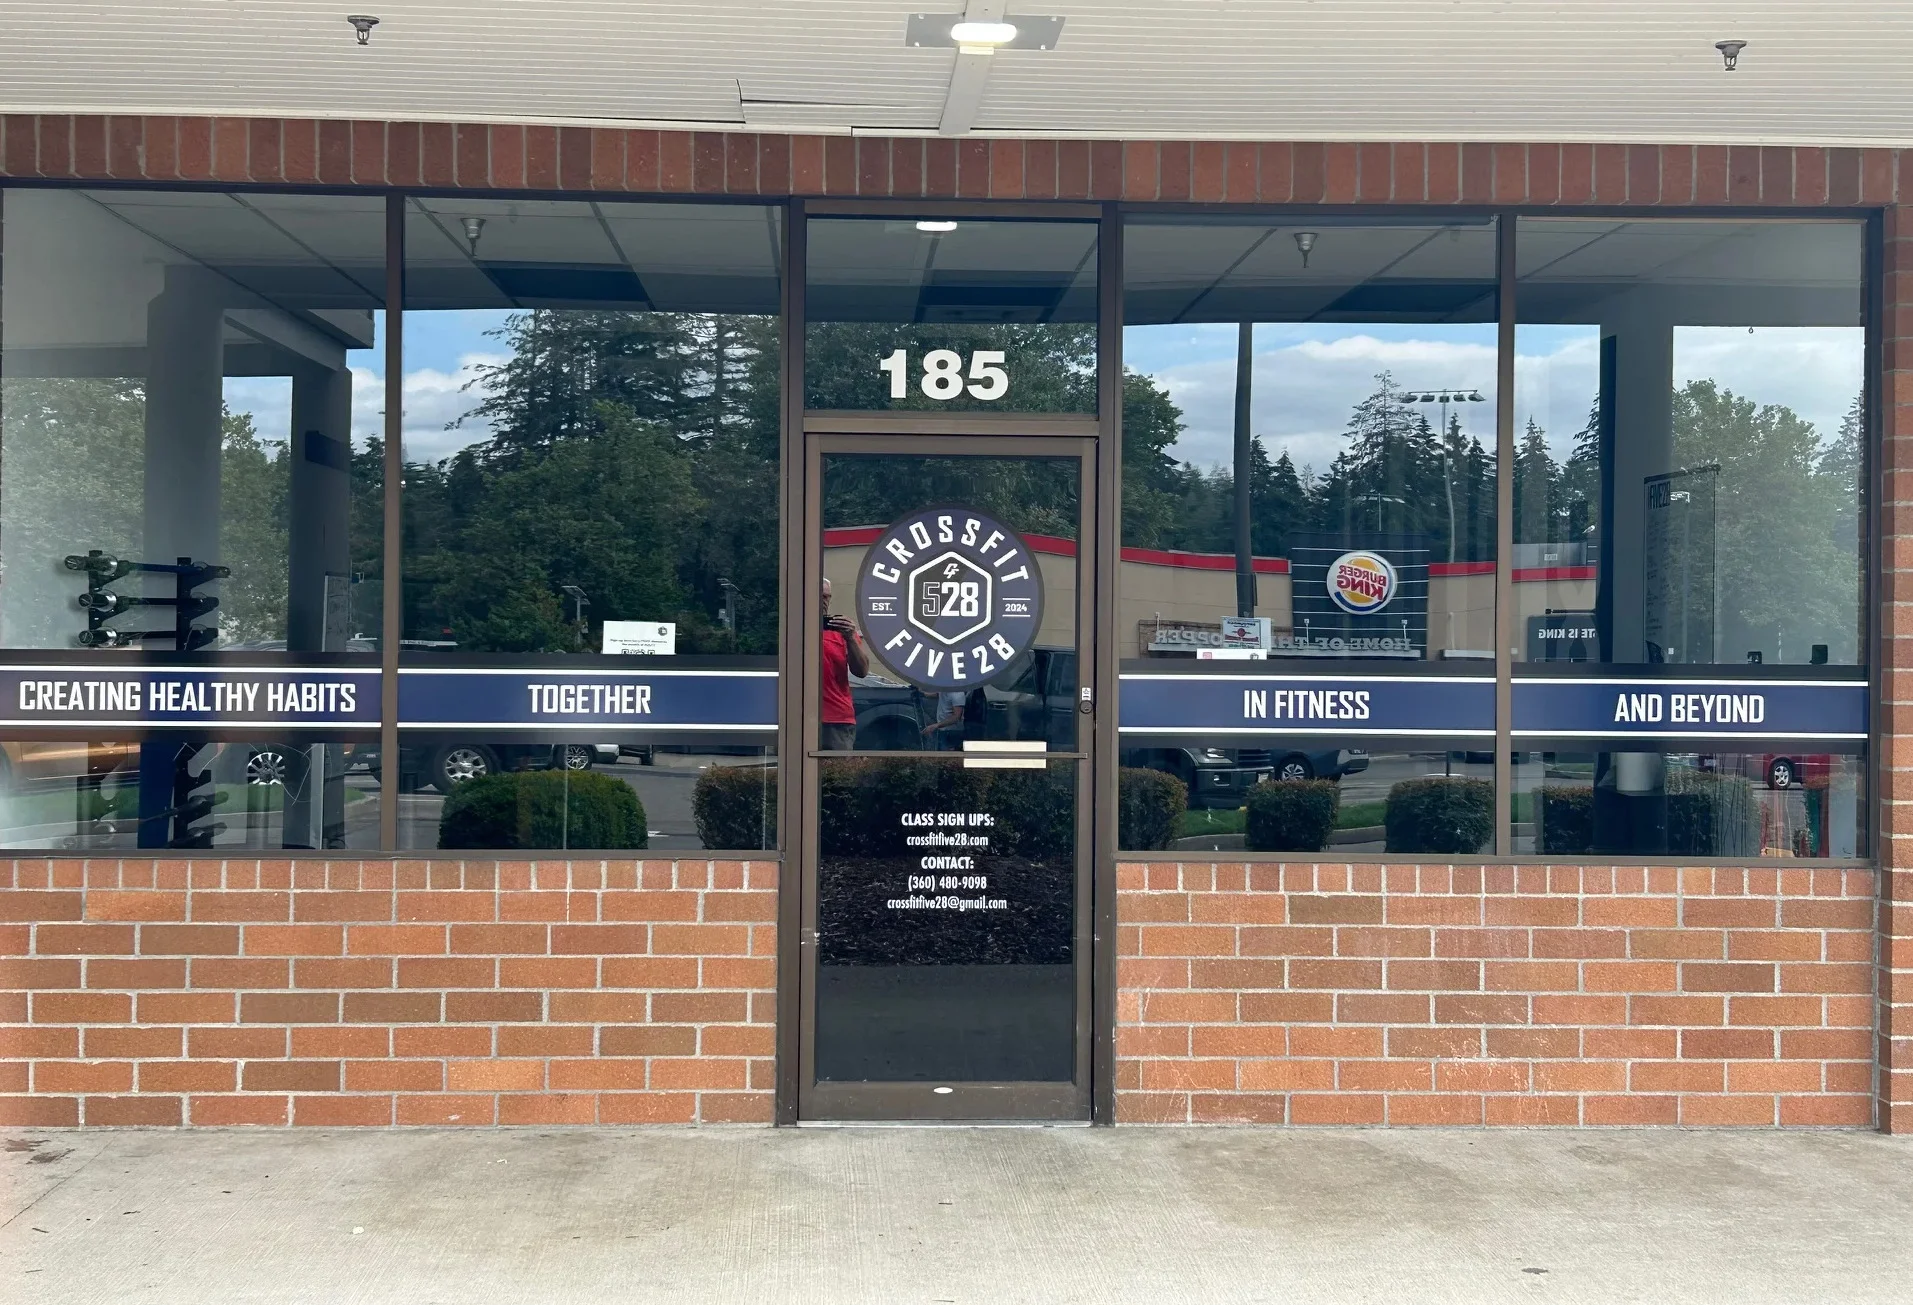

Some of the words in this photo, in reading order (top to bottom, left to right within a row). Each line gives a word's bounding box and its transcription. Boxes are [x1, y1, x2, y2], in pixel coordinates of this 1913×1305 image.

[880, 349, 1009, 400] 185
[872, 515, 1029, 584] CROSSFIT
[872, 602, 893, 611] EST.
[922, 581, 979, 617] 528
[1005, 604, 1027, 612] 2024
[884, 629, 1016, 680] FIVE28
[19, 680, 141, 711] CREATING
[150, 682, 260, 712] HEALTHY
[267, 682, 356, 713] HABITS
[528, 684, 652, 714] TOGETHER
[1244, 690, 1267, 719] IN
[1275, 690, 1370, 719] FITNESS
[1614, 693, 1662, 722] AND
[1670, 694, 1765, 723] BEYOND
[901, 813, 934, 826] CLASS
[937, 813, 965, 826] SIGN
[968, 813, 995, 826] UPS:
[906, 832, 989, 846] crossfitfive28.com
[921, 856, 975, 869] CONTACT:
[908, 875, 936, 892] (360)
[939, 876, 987, 889] 480-9098
[887, 895, 1008, 911] crossfitfive28@gmail.com
